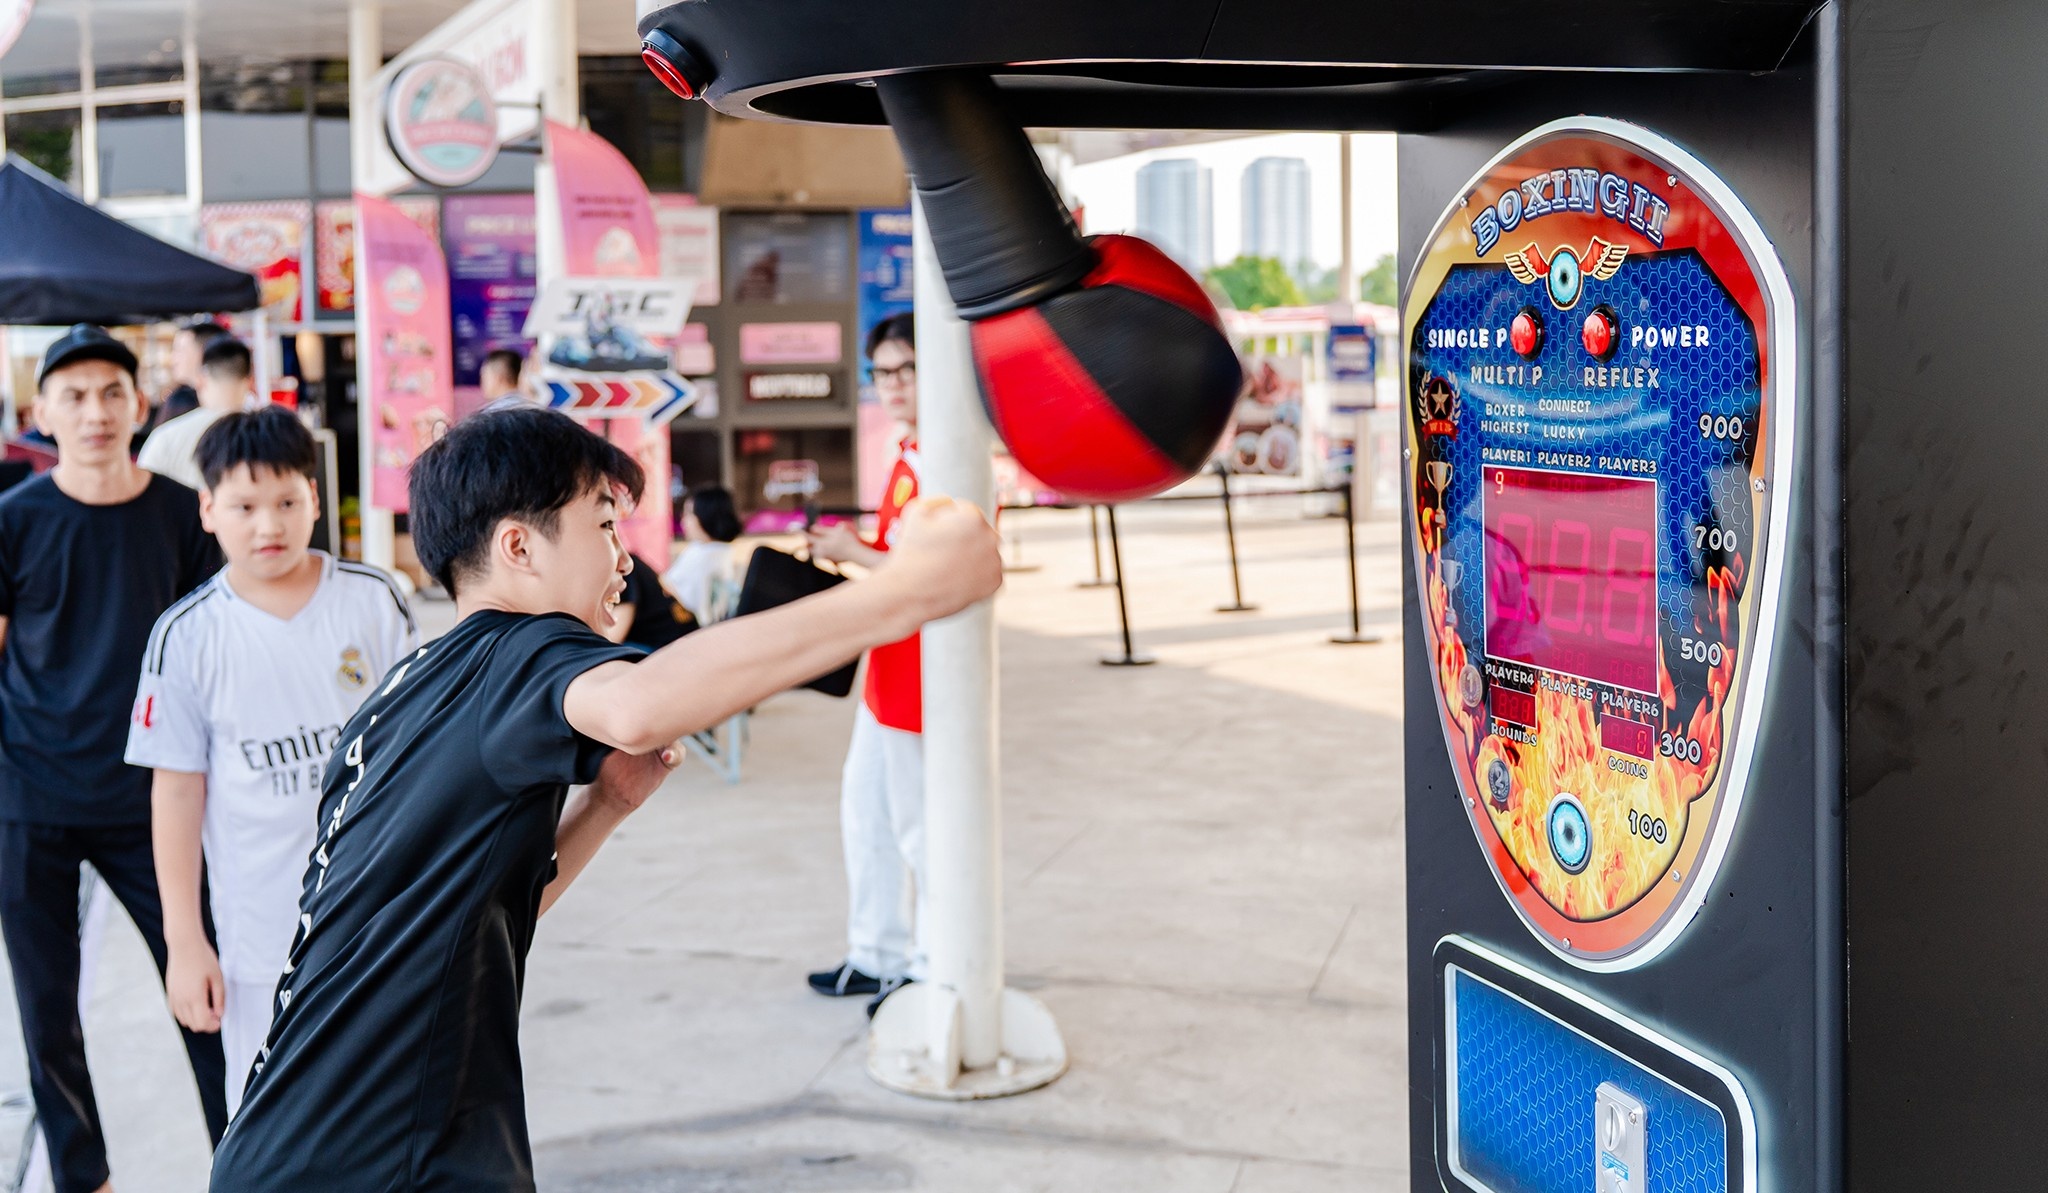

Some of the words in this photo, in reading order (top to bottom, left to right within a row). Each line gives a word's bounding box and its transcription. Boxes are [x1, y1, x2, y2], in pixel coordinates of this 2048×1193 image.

[1428, 328, 1489, 349] SINGLE
[1496, 328, 1507, 349] P
[1631, 325, 1710, 348] POWER
[1470, 365, 1523, 386] MULTI
[1532, 365, 1543, 386] P
[1583, 366, 1660, 389] REFLEX
[1485, 402, 1526, 418] BOXER
[1538, 398, 1592, 413] CONNECT
[1480, 420, 1530, 435] HIGHEST
[1542, 424, 1586, 440] LUCKY
[1699, 413, 1744, 440] 900
[1481, 447, 1531, 463] PLAYER1
[1537, 451, 1592, 468] PLAYER2
[1598, 456, 1658, 474] PLAYER3
[1495, 471, 1504, 495] 9
[1694, 525, 1738, 553] 700
[1680, 637, 1722, 667] 500
[1485, 662, 1535, 686] PLAYER4
[1540, 676, 1594, 701] PLAYER5
[1601, 691, 1659, 717] PLAYER6
[1491, 722, 1537, 747] ROUNDS
[241, 724, 342, 770] Emira
[1660, 731, 1702, 765] 300
[1608, 756, 1648, 780] COINS
[1628, 808, 1667, 844] 100
